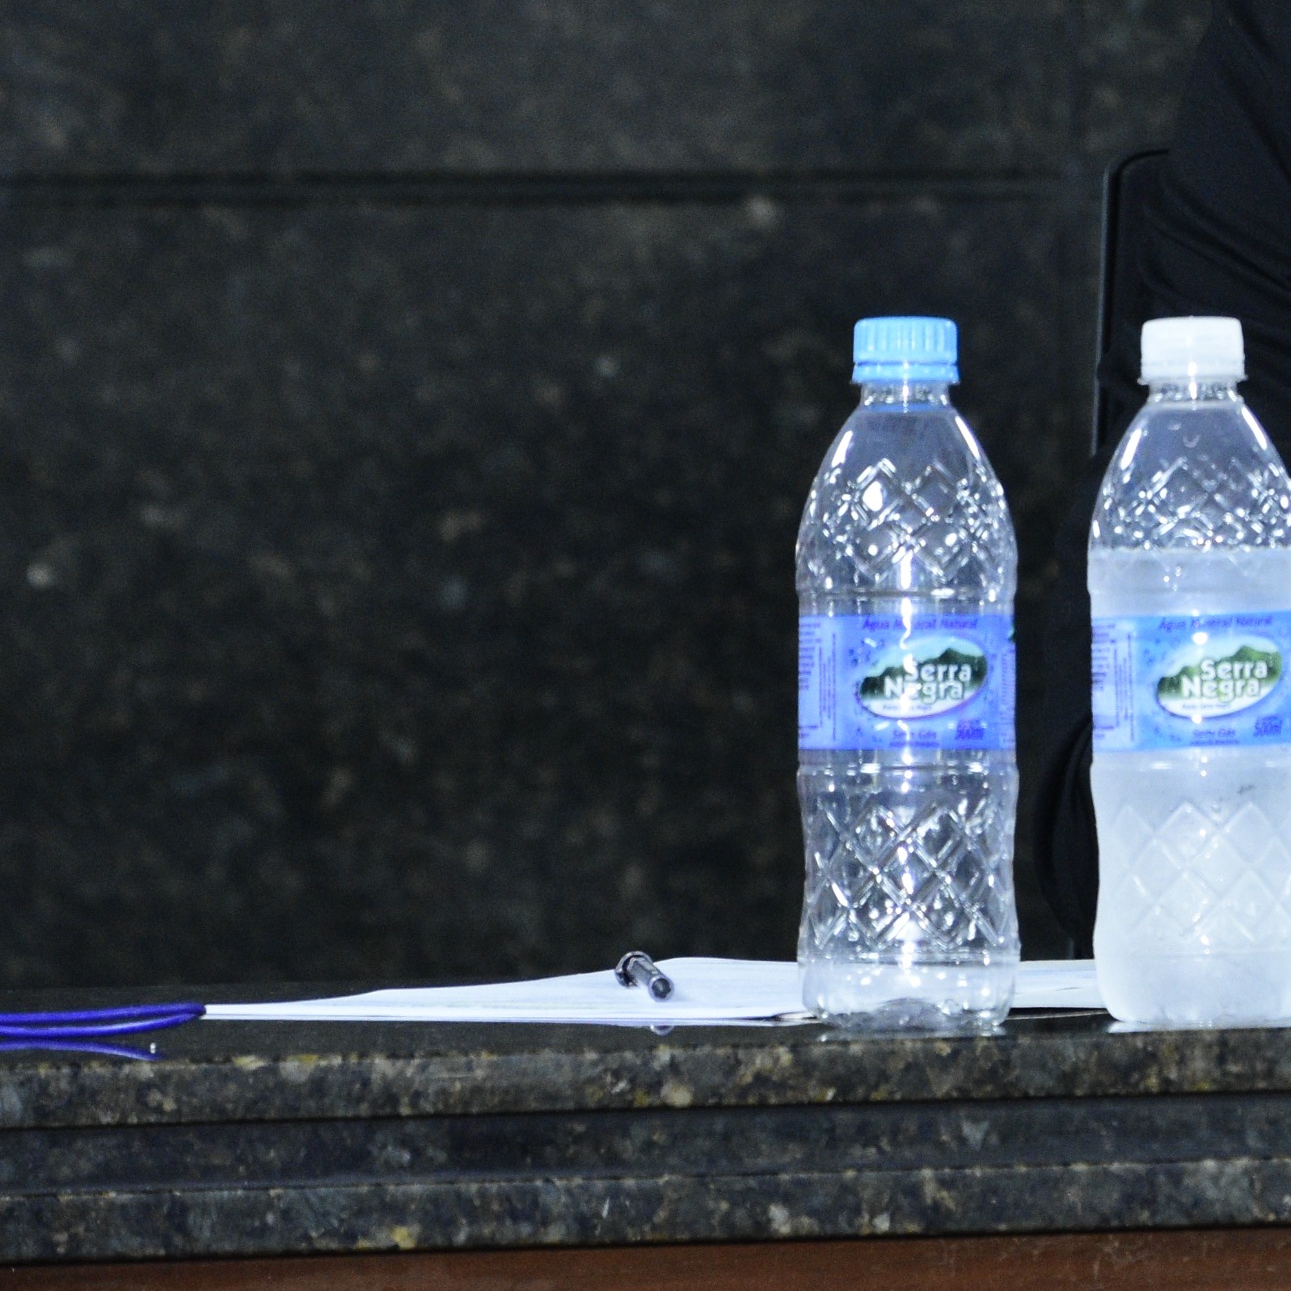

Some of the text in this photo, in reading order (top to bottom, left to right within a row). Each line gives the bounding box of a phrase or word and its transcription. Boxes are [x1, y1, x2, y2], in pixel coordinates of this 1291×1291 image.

[903, 658, 973, 682] Serra
[1201, 659, 1269, 681] Serra
[883, 676, 965, 704] Negra
[1180, 675, 1261, 703] Negra
